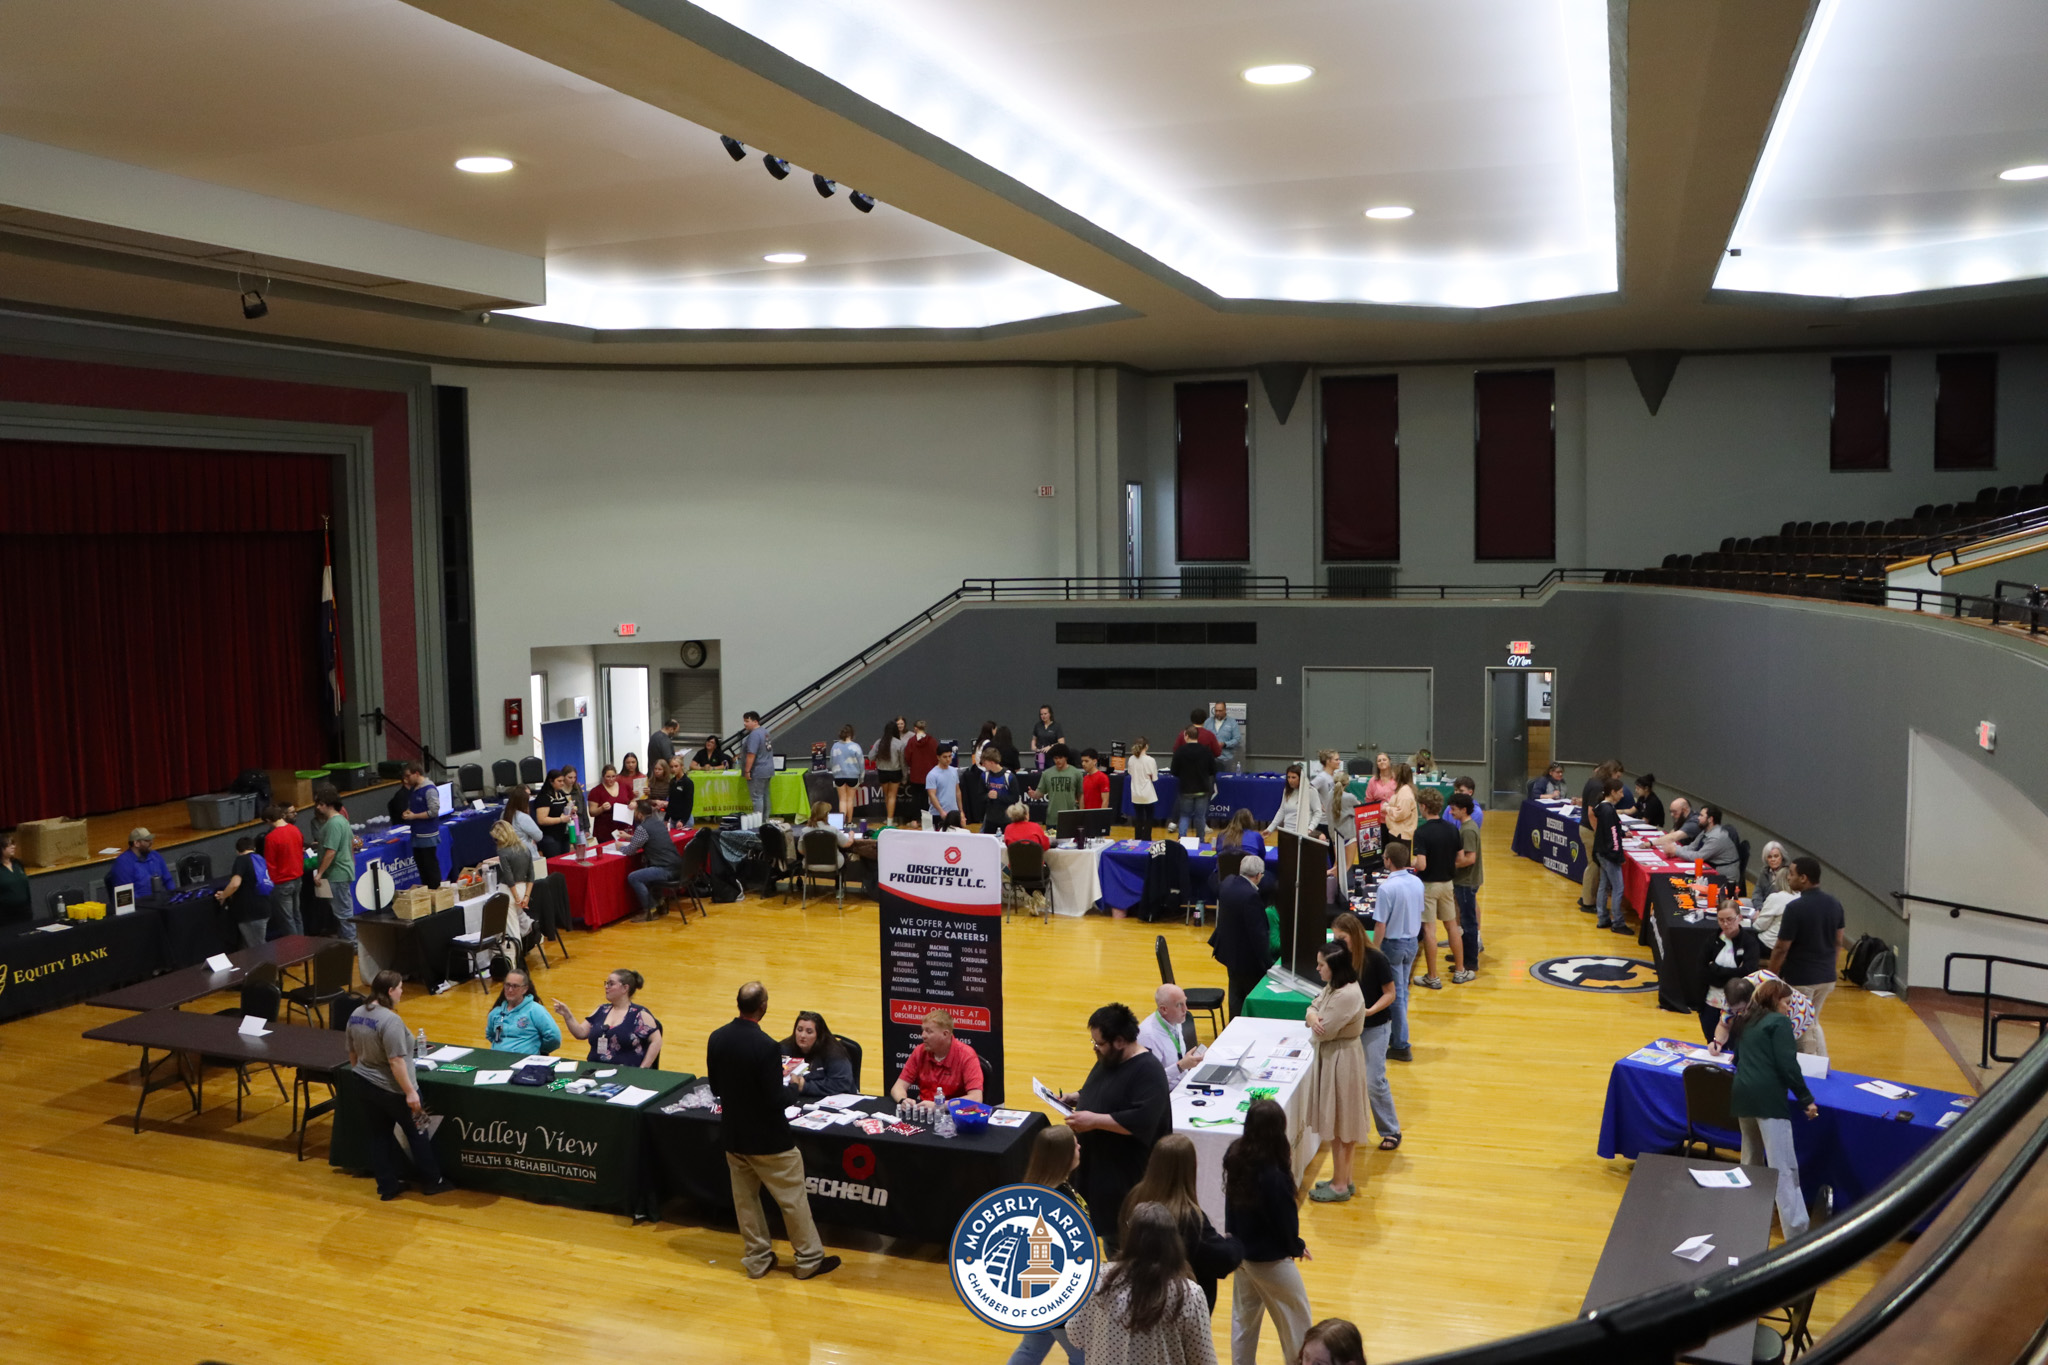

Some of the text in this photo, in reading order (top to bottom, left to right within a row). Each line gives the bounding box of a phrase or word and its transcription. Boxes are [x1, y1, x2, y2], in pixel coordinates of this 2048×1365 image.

[621, 624, 635, 635] EXIT
[1513, 641, 1529, 653] EXIT
[871, 785, 912, 798] MCC
[1543, 829, 1568, 847] DEPARTMENT
[889, 873, 986, 888] PRODUCTS L.L.C.
[900, 917, 914, 926] WE
[916, 919, 942, 928] OFFER
[954, 922, 977, 931] WIDE
[889, 927, 988, 942] VARIETY OF CAREERS!
[894, 941, 916, 949] ASSEMBLY
[890, 950, 919, 959] ENGINEERING
[960, 956, 988, 964] SCHEDULING
[13, 946, 108, 984] EQUITY BANK
[897, 960, 914, 968] HUMAN
[926, 960, 953, 968] WAREHOUSE
[893, 967, 918, 975] RESOURCES
[892, 976, 920, 984] ACCOUNTING
[926, 988, 955, 997] PURCHASING
[901, 1004, 927, 1013] APPLY
[968, 1010, 980, 1018] AT
[452, 1116, 598, 1157] Valley View
[461, 1153, 597, 1180] HEALTH & REHABILITATION
[805, 1176, 889, 1207] SCHELN
